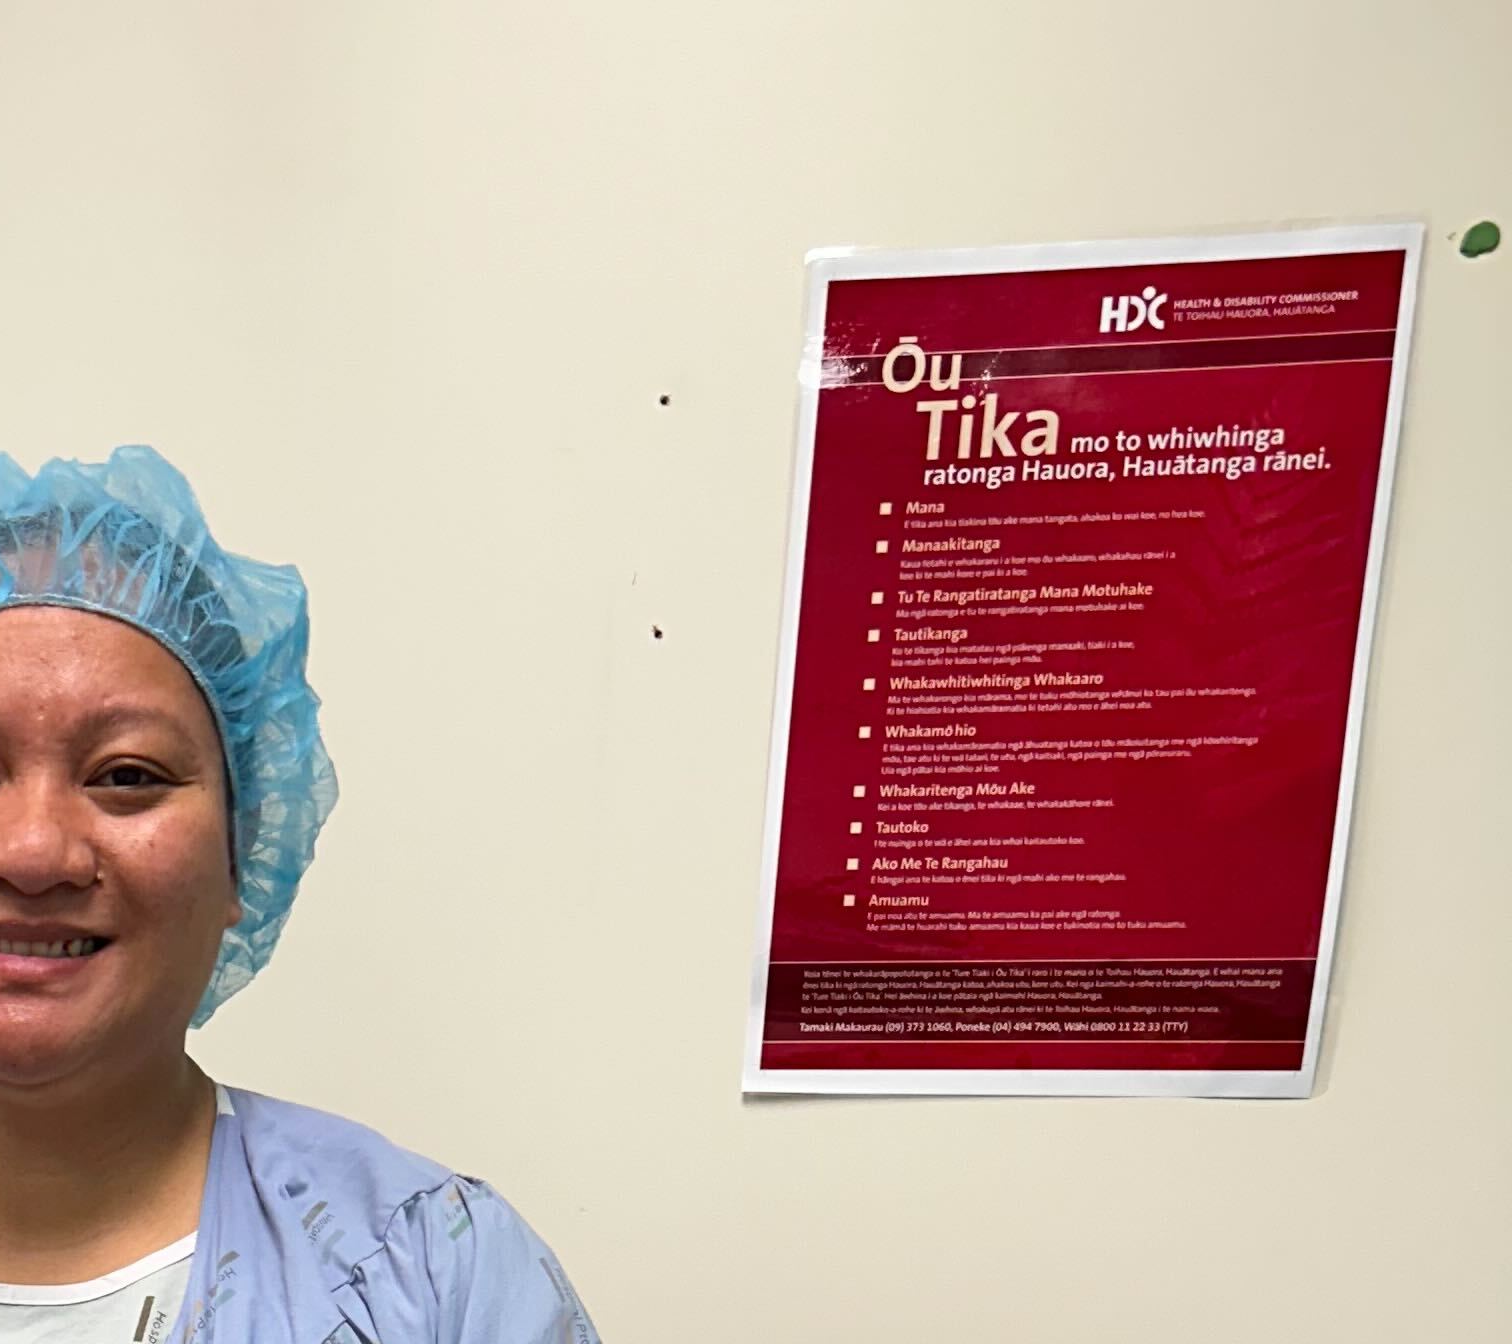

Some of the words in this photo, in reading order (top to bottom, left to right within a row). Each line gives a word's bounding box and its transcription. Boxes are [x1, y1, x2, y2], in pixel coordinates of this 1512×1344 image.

[1174, 299, 1211, 310] HEALTH
[1224, 295, 1277, 308] DISABILITY
[1279, 290, 1359, 304] COMMISSIONER
[1099, 286, 1168, 333] HDC
[1173, 311, 1183, 321] TE
[916, 393, 1060, 461] Tika
[1071, 434, 1109, 453] mo
[1115, 431, 1140, 451] to
[1147, 425, 1285, 451] whiwhinga
[924, 465, 1015, 489] ratonga
[1022, 460, 1117, 482] Hauora,
[906, 502, 945, 514] Mana
[902, 537, 1001, 554] Manaakitanga
[898, 591, 914, 603] Tu
[915, 590, 930, 602] Te
[934, 587, 1037, 605] Rangatiratanga
[1040, 586, 1079, 598] Mana
[1082, 582, 1153, 597] Motuhake
[894, 628, 968, 642] Tautikanga
[890, 675, 1030, 691] Whakawhitiwhitinga
[1033, 673, 1103, 686] Whakaaro
[880, 784, 972, 799] Whakaritenga
[1009, 782, 1035, 795] Ake
[876, 820, 929, 834] Tautoko
[872, 858, 899, 871] Ako
[901, 858, 922, 870] Me
[925, 858, 939, 870] Te
[942, 857, 1008, 873] Rangahau
[869, 894, 929, 907] Amuamu
